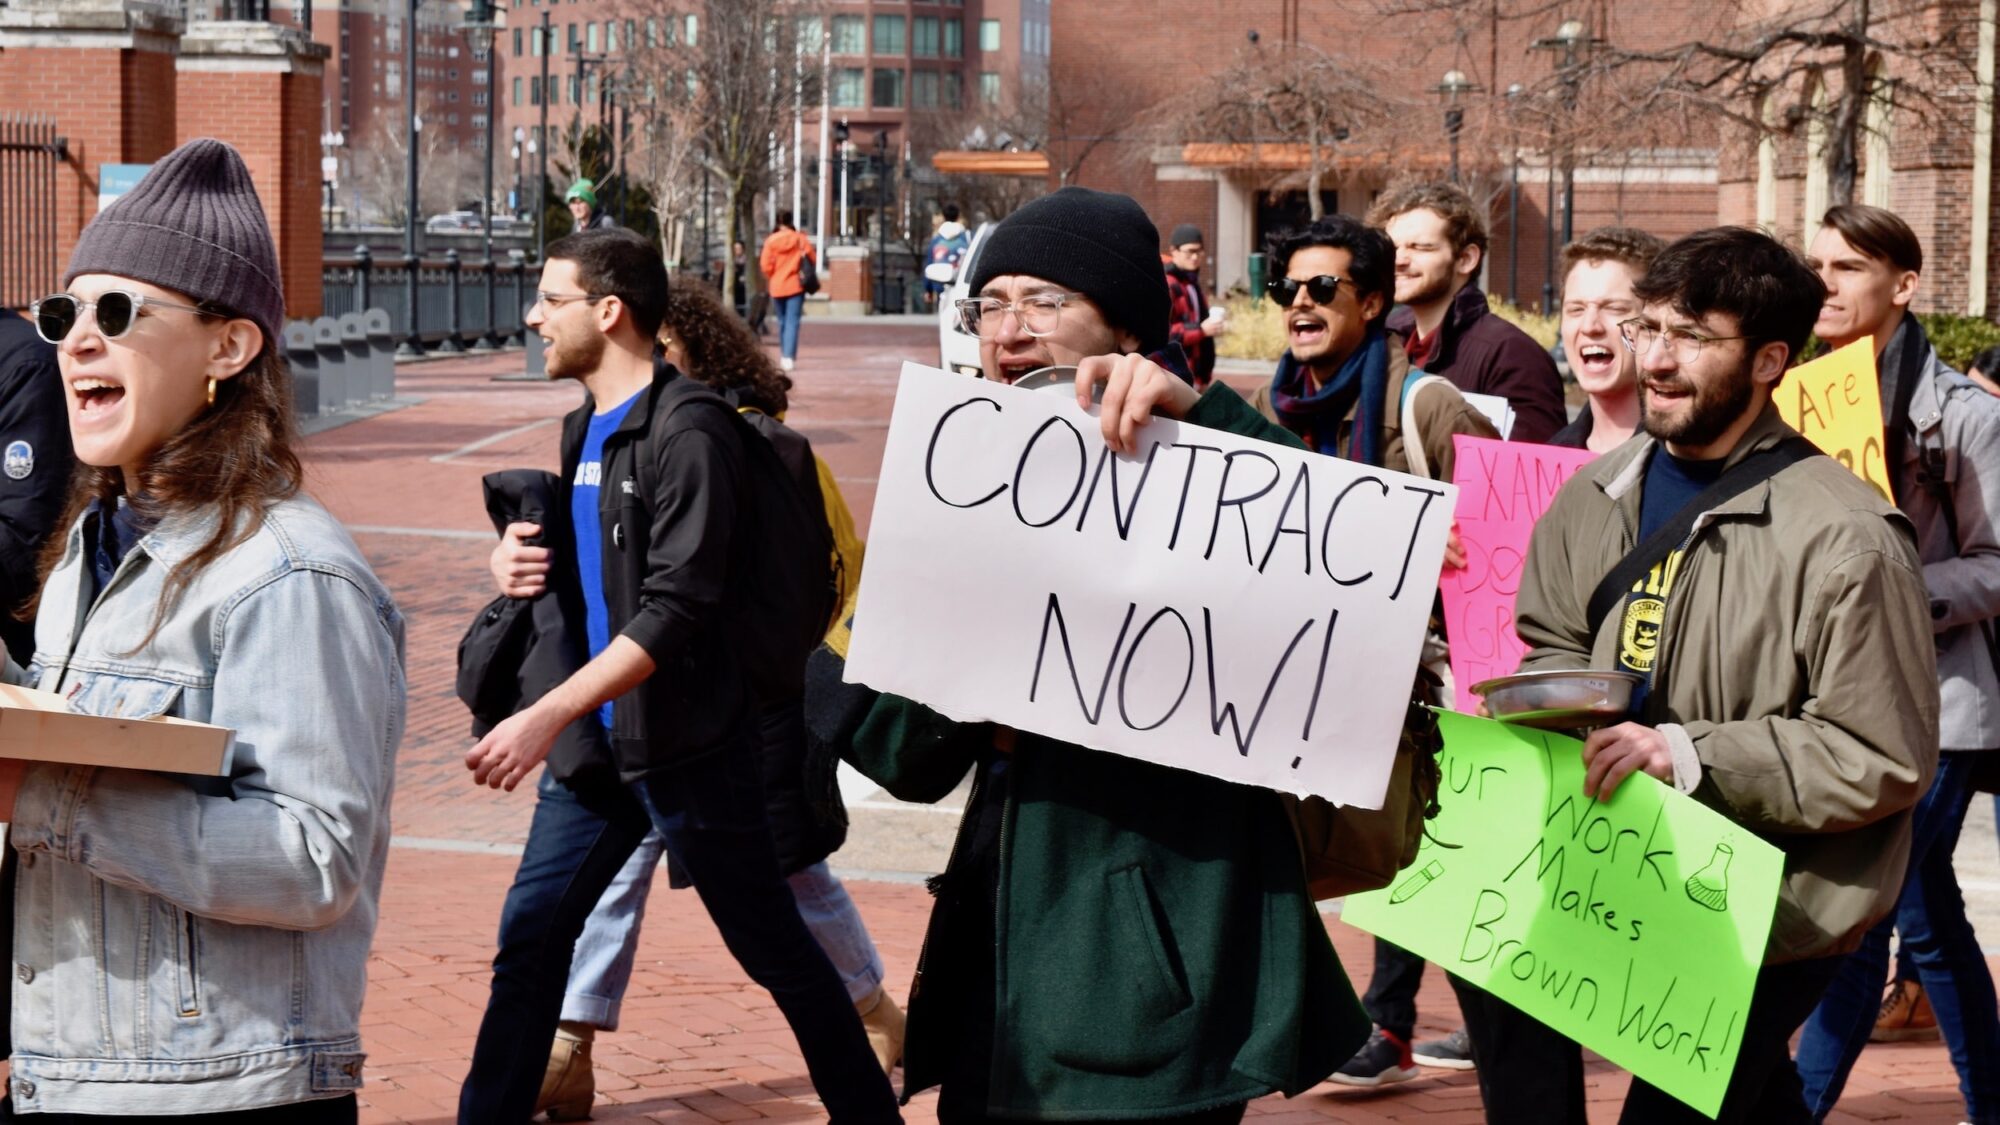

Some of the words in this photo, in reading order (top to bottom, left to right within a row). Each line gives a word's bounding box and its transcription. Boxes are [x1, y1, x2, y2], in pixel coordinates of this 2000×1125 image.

[1798, 373, 1861, 434] Are
[925, 397, 1445, 601] CONTRACT
[1455, 446, 1583, 522] EXAM
[1029, 592, 1339, 770] NOW!
[1438, 747, 1508, 801] ur
[1543, 734, 1673, 892] Work
[1502, 837, 1643, 941] Makes
[1459, 888, 1599, 1021] Brown
[1617, 957, 1738, 1073] Work!
